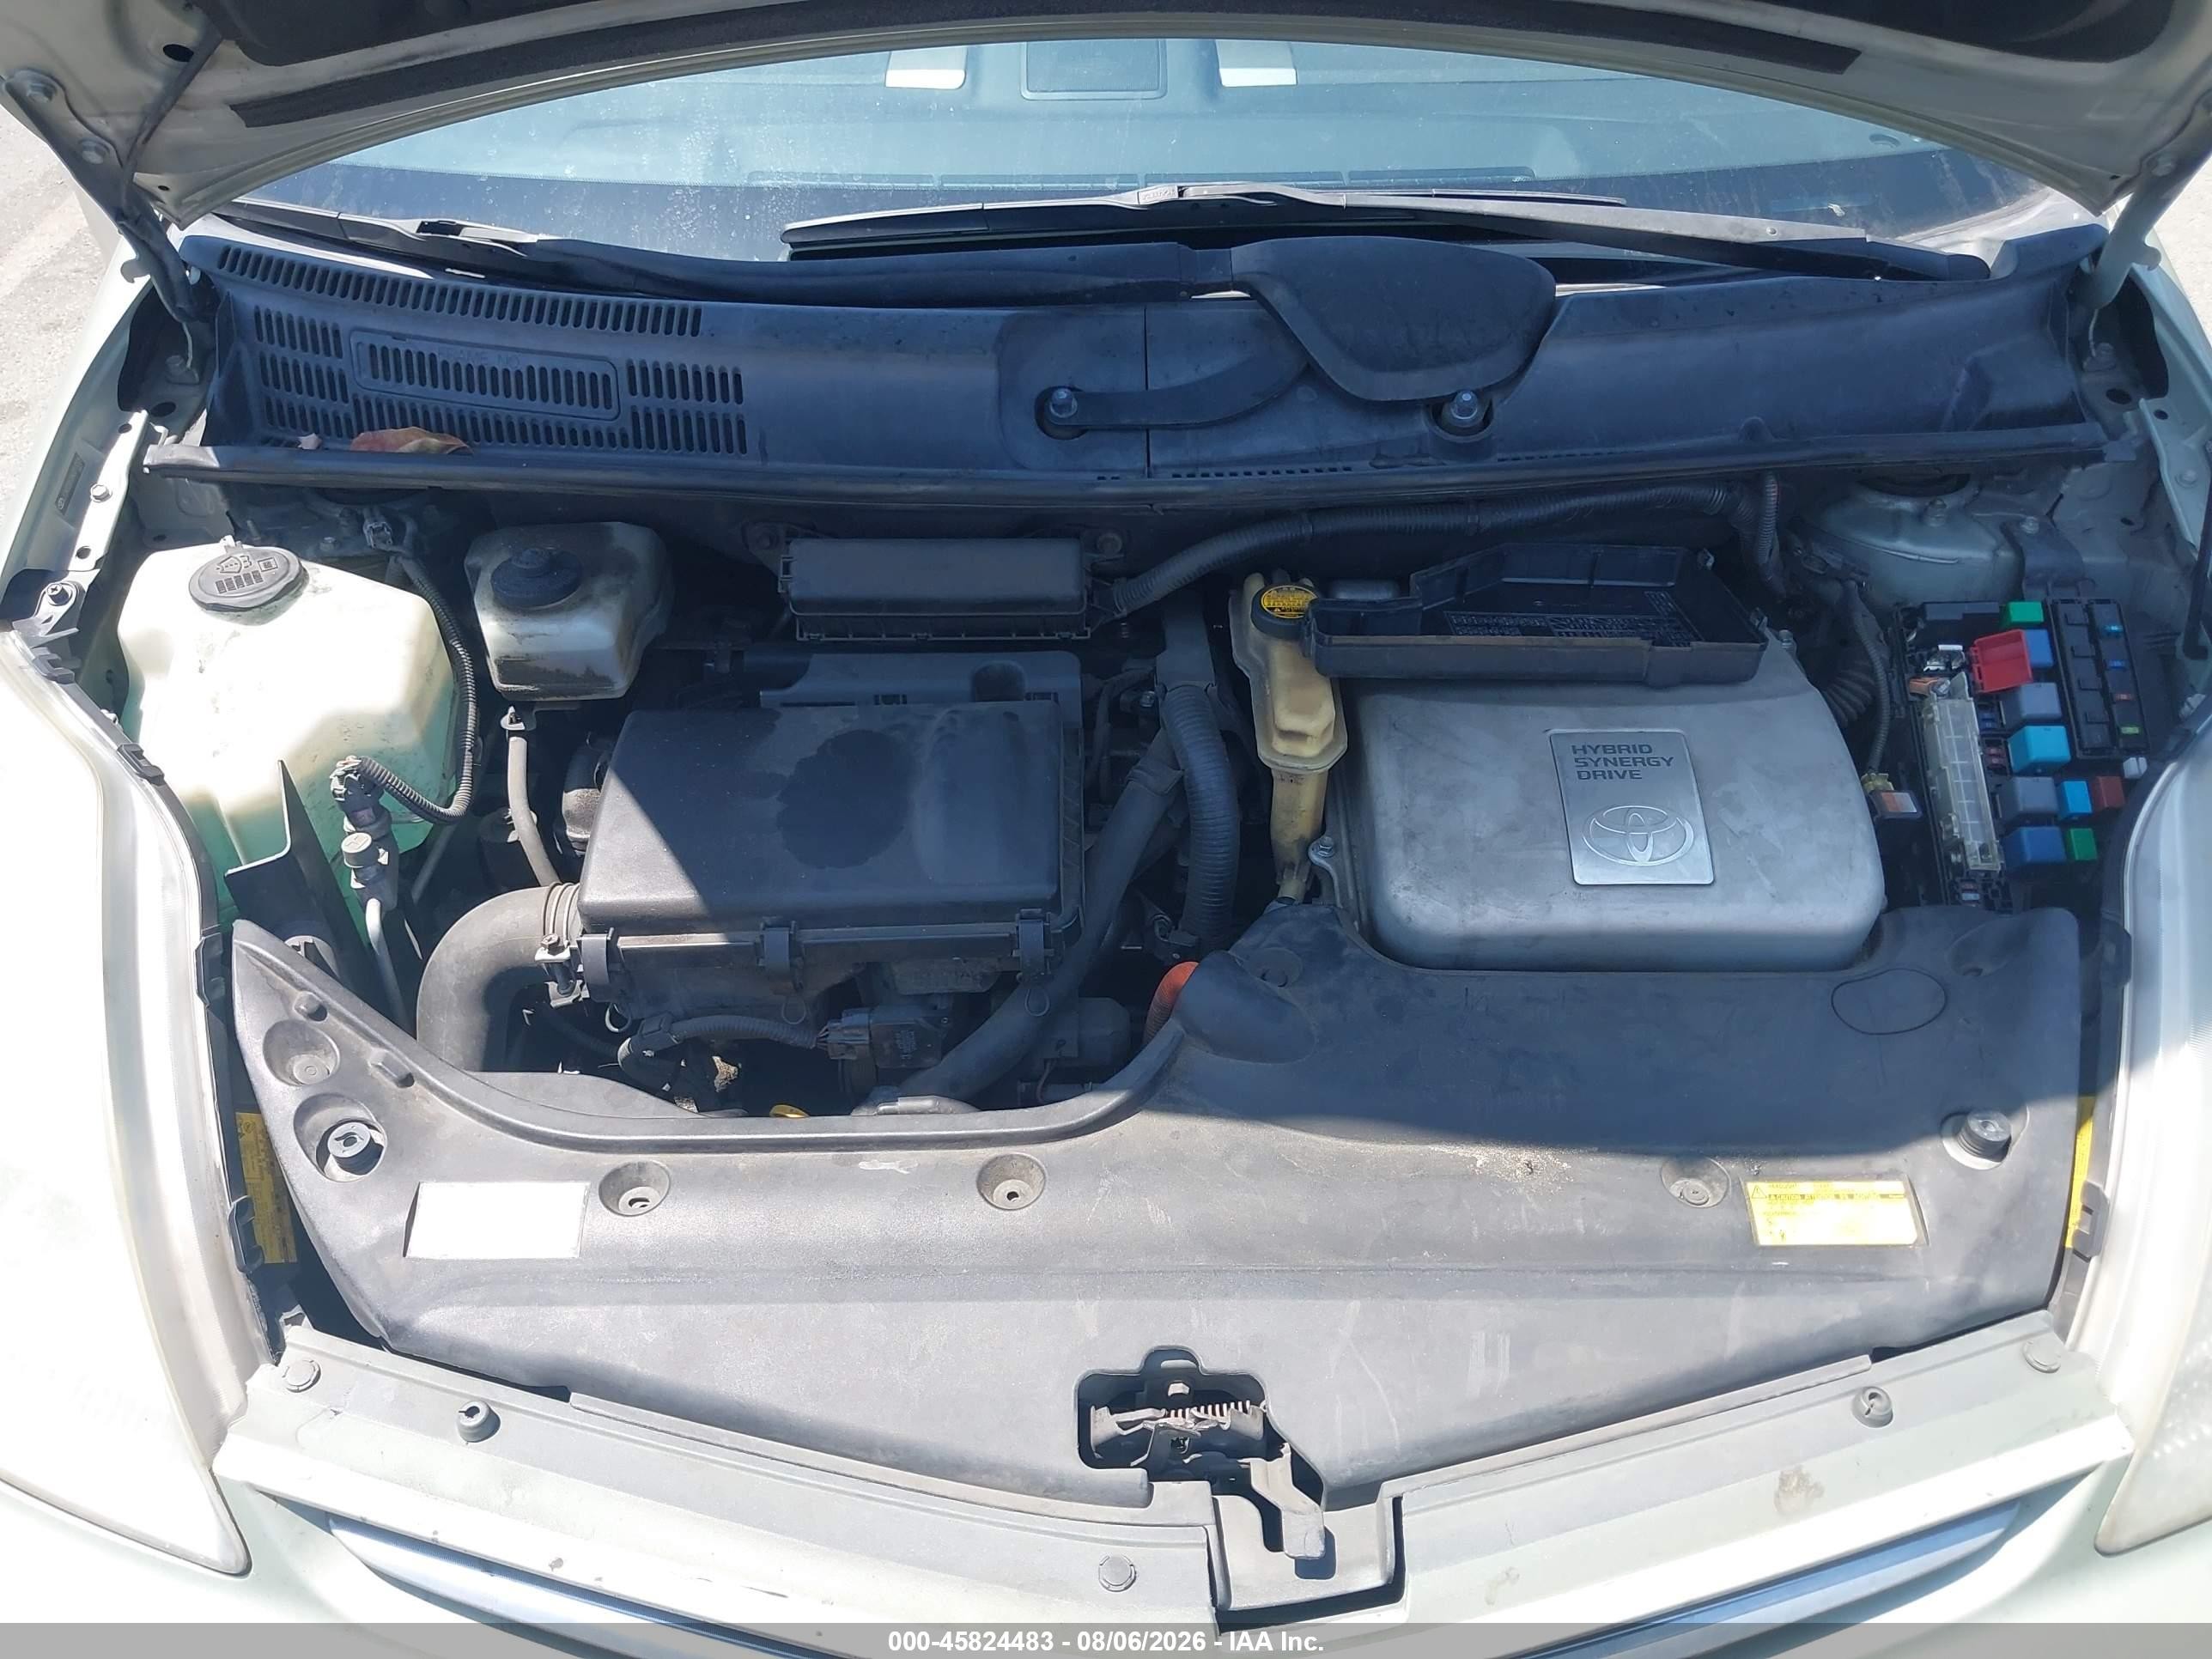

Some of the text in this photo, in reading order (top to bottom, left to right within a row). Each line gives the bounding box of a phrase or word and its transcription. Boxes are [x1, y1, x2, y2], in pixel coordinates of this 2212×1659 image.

[1571, 744, 1653, 755] HYBRID
[1574, 757, 1674, 768] SYNERGY
[1577, 769, 1643, 781] DRIVE
